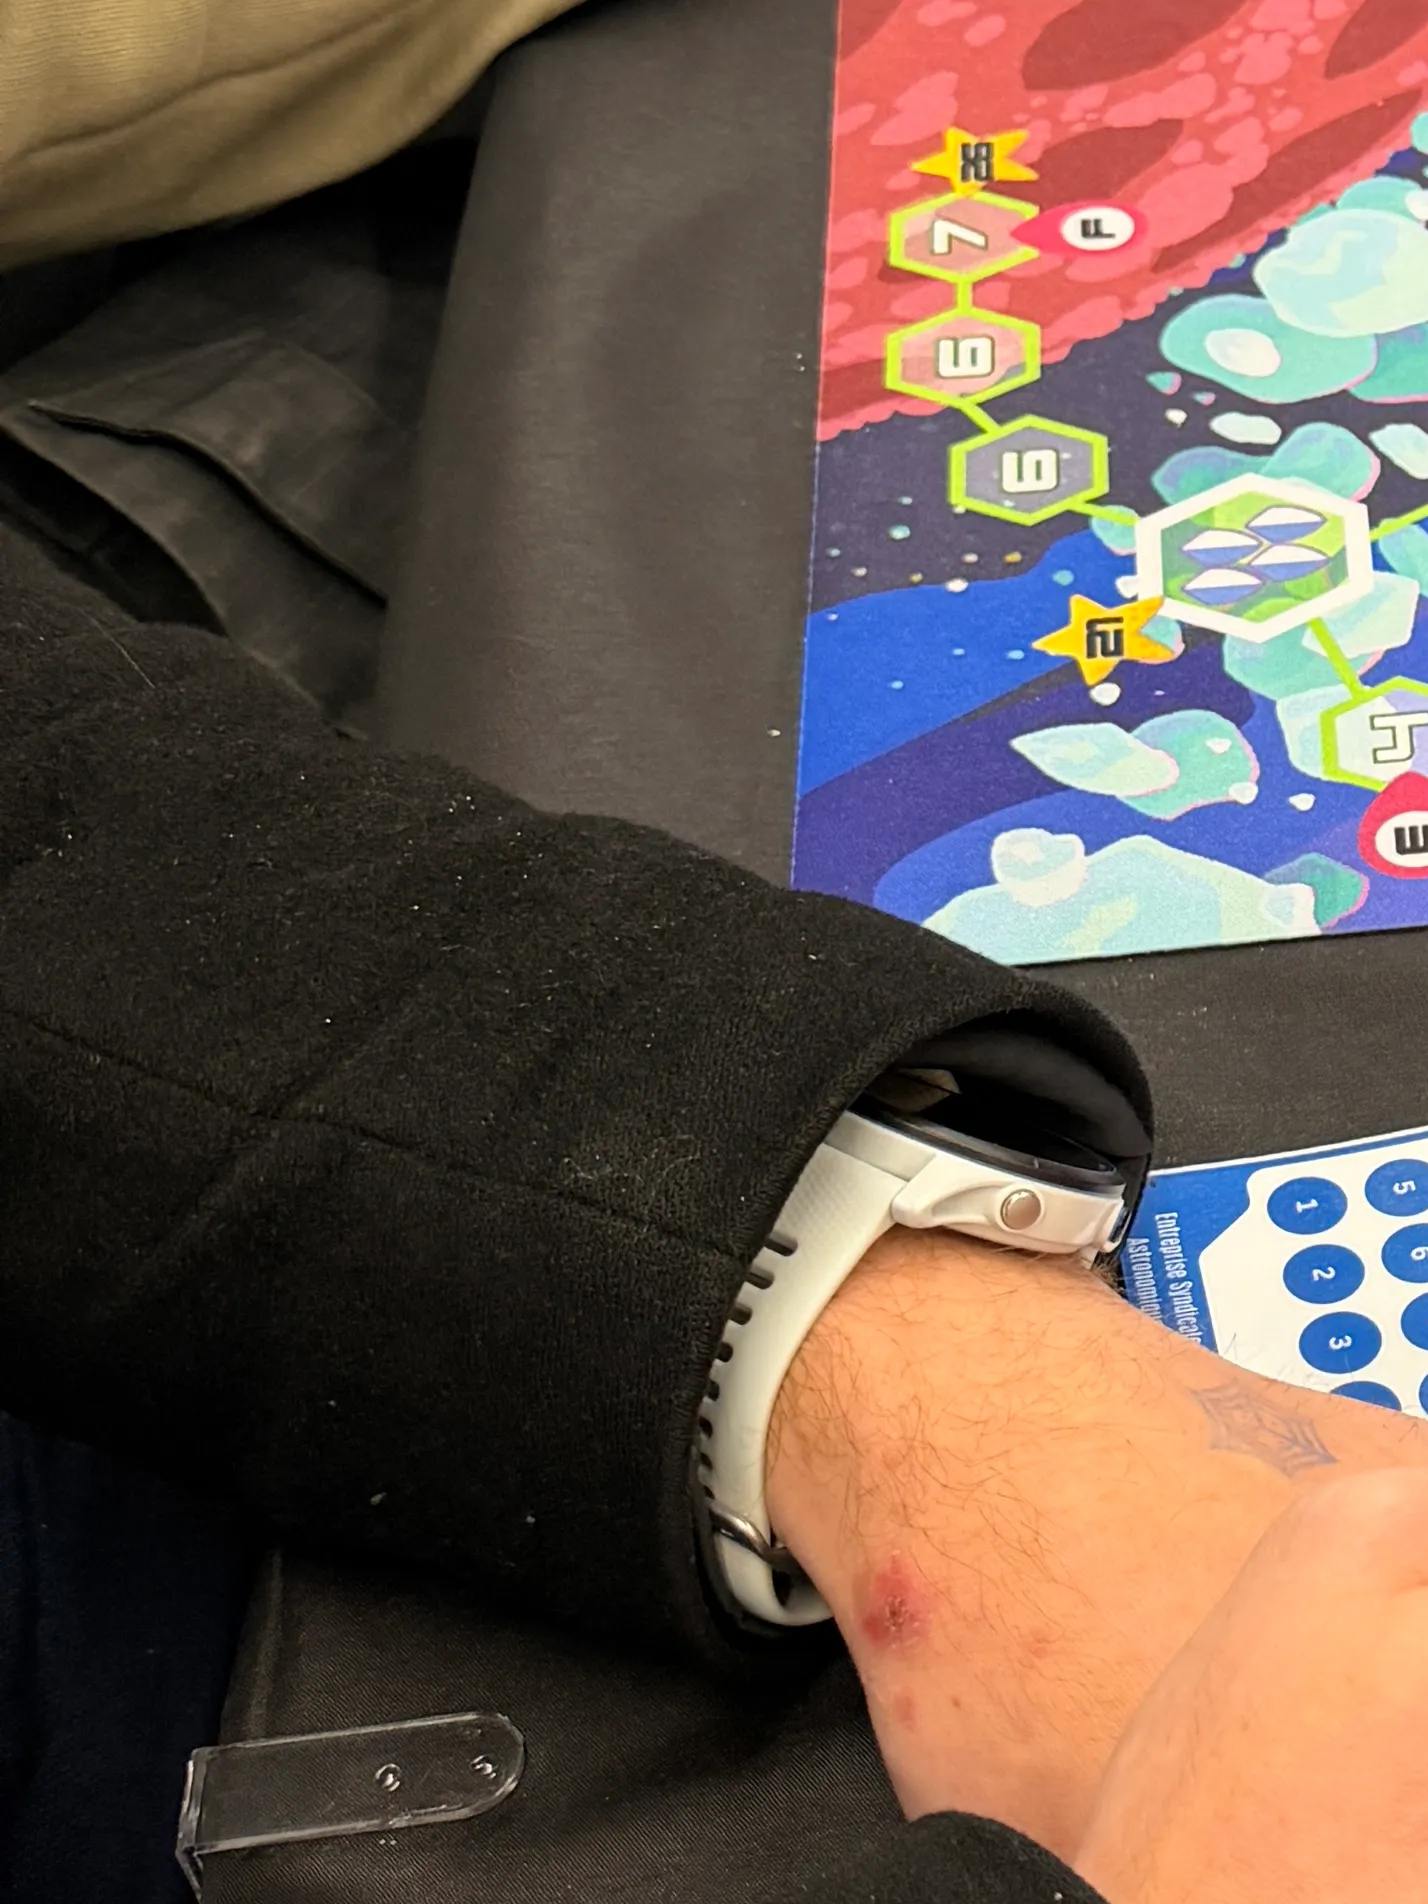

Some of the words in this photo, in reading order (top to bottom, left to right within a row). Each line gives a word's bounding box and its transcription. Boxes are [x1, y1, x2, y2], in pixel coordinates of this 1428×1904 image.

[932, 214, 990, 257] 7
[1080, 216, 1118, 243] F
[936, 336, 994, 380] 6
[1001, 448, 1060, 493] 6
[1395, 1179, 1417, 1197] 5
[1296, 1198, 1320, 1213] 1
[1154, 1211, 1189, 1279] Entreprise
[1312, 1266, 1337, 1282] 2
[1328, 1335, 1353, 1351] 3
